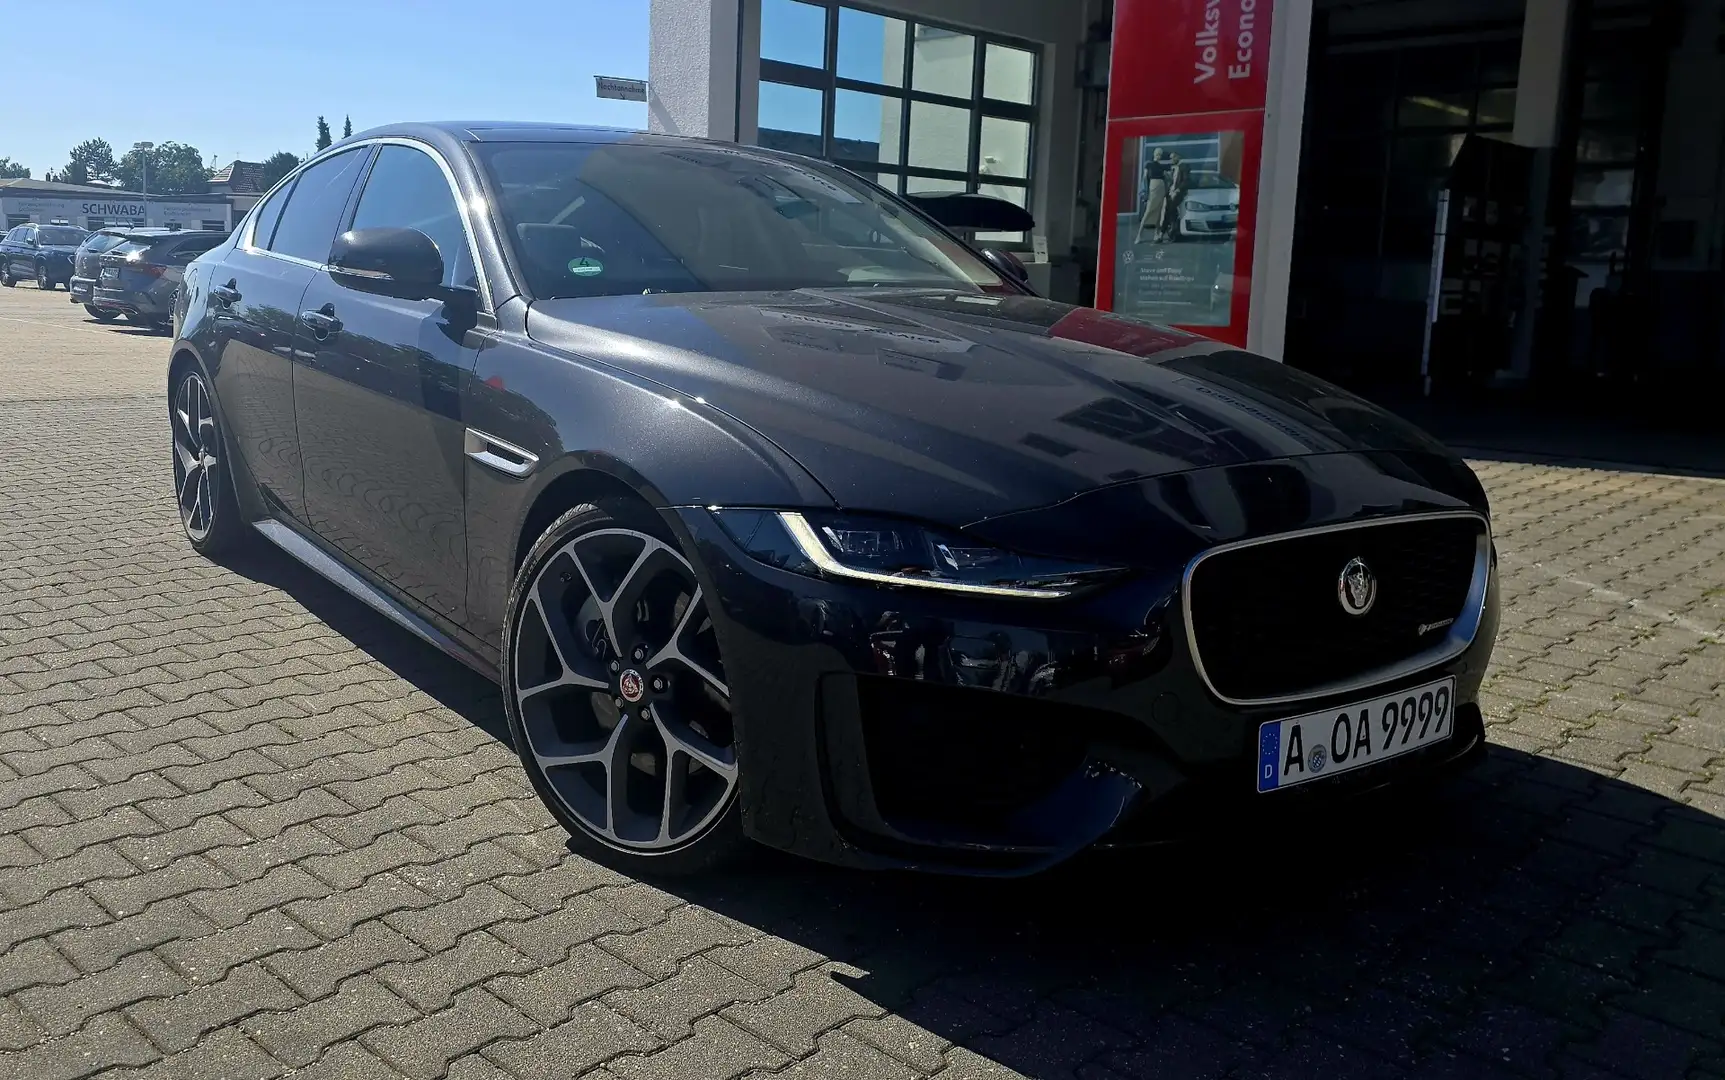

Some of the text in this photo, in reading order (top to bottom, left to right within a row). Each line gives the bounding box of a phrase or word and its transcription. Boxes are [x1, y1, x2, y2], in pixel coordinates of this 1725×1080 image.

[82, 203, 145, 216] SCHWABA
[1283, 686, 1450, 776] A OA 9999
[1264, 764, 1273, 779] D
